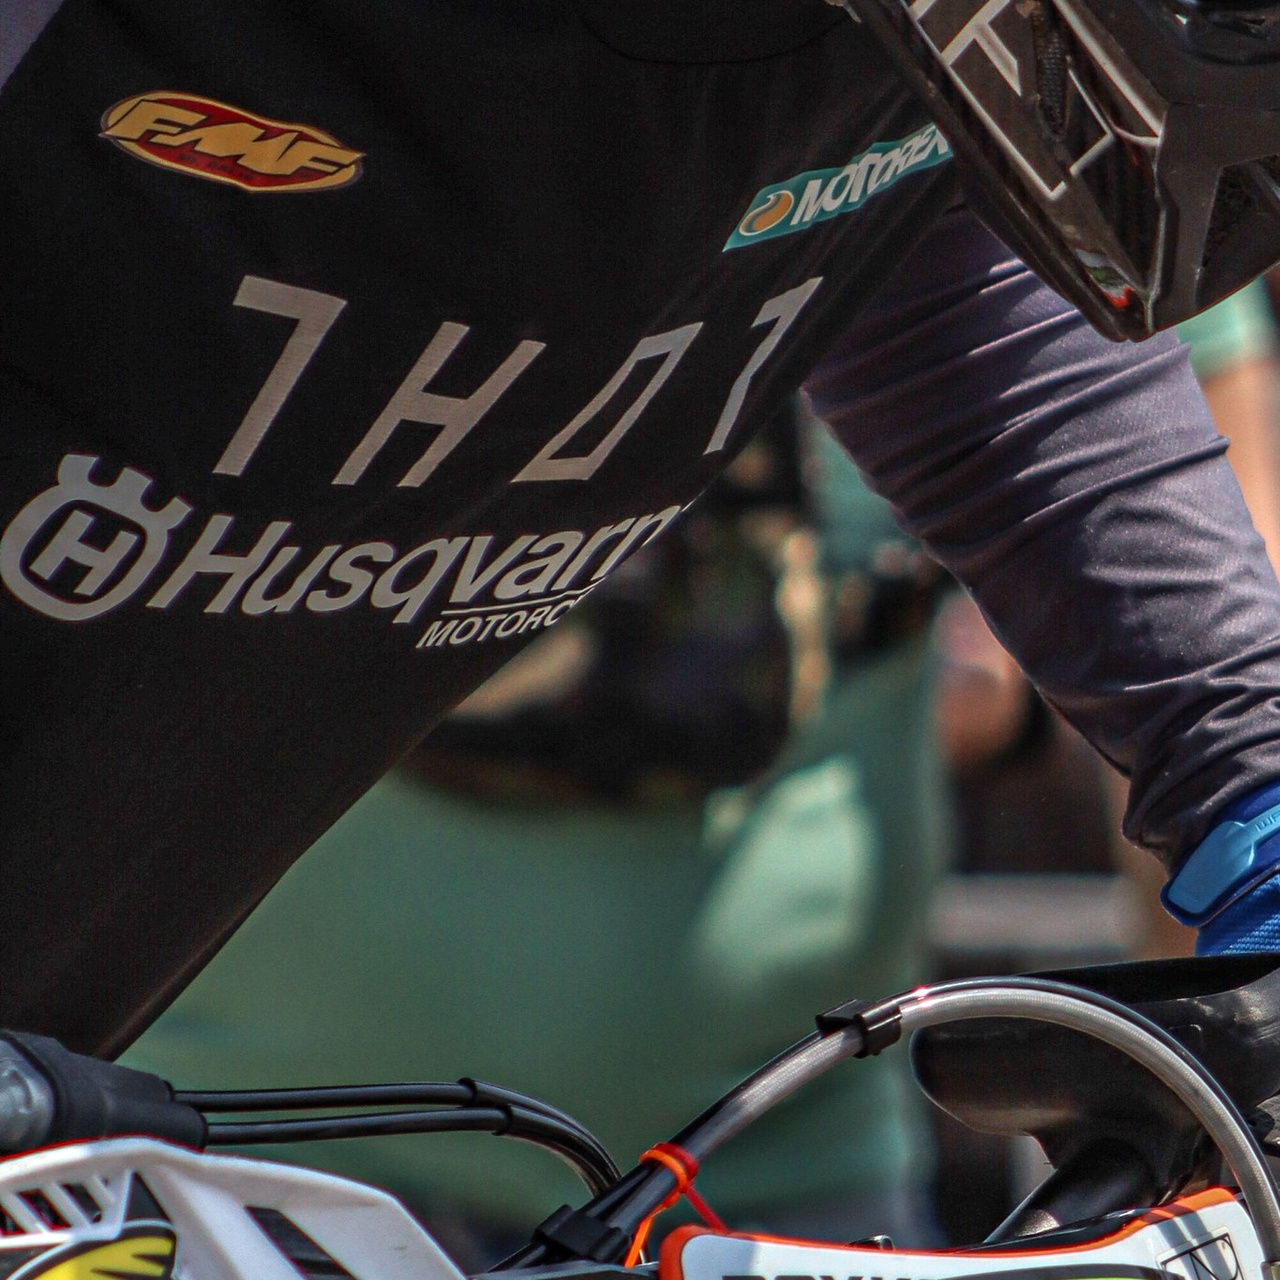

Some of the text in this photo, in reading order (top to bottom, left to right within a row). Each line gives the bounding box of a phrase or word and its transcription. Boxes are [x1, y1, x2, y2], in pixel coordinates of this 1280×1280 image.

[98, 100, 364, 176] FMF
[146, 503, 688, 624] Husqvarn
[416, 590, 590, 649] MOTORC
